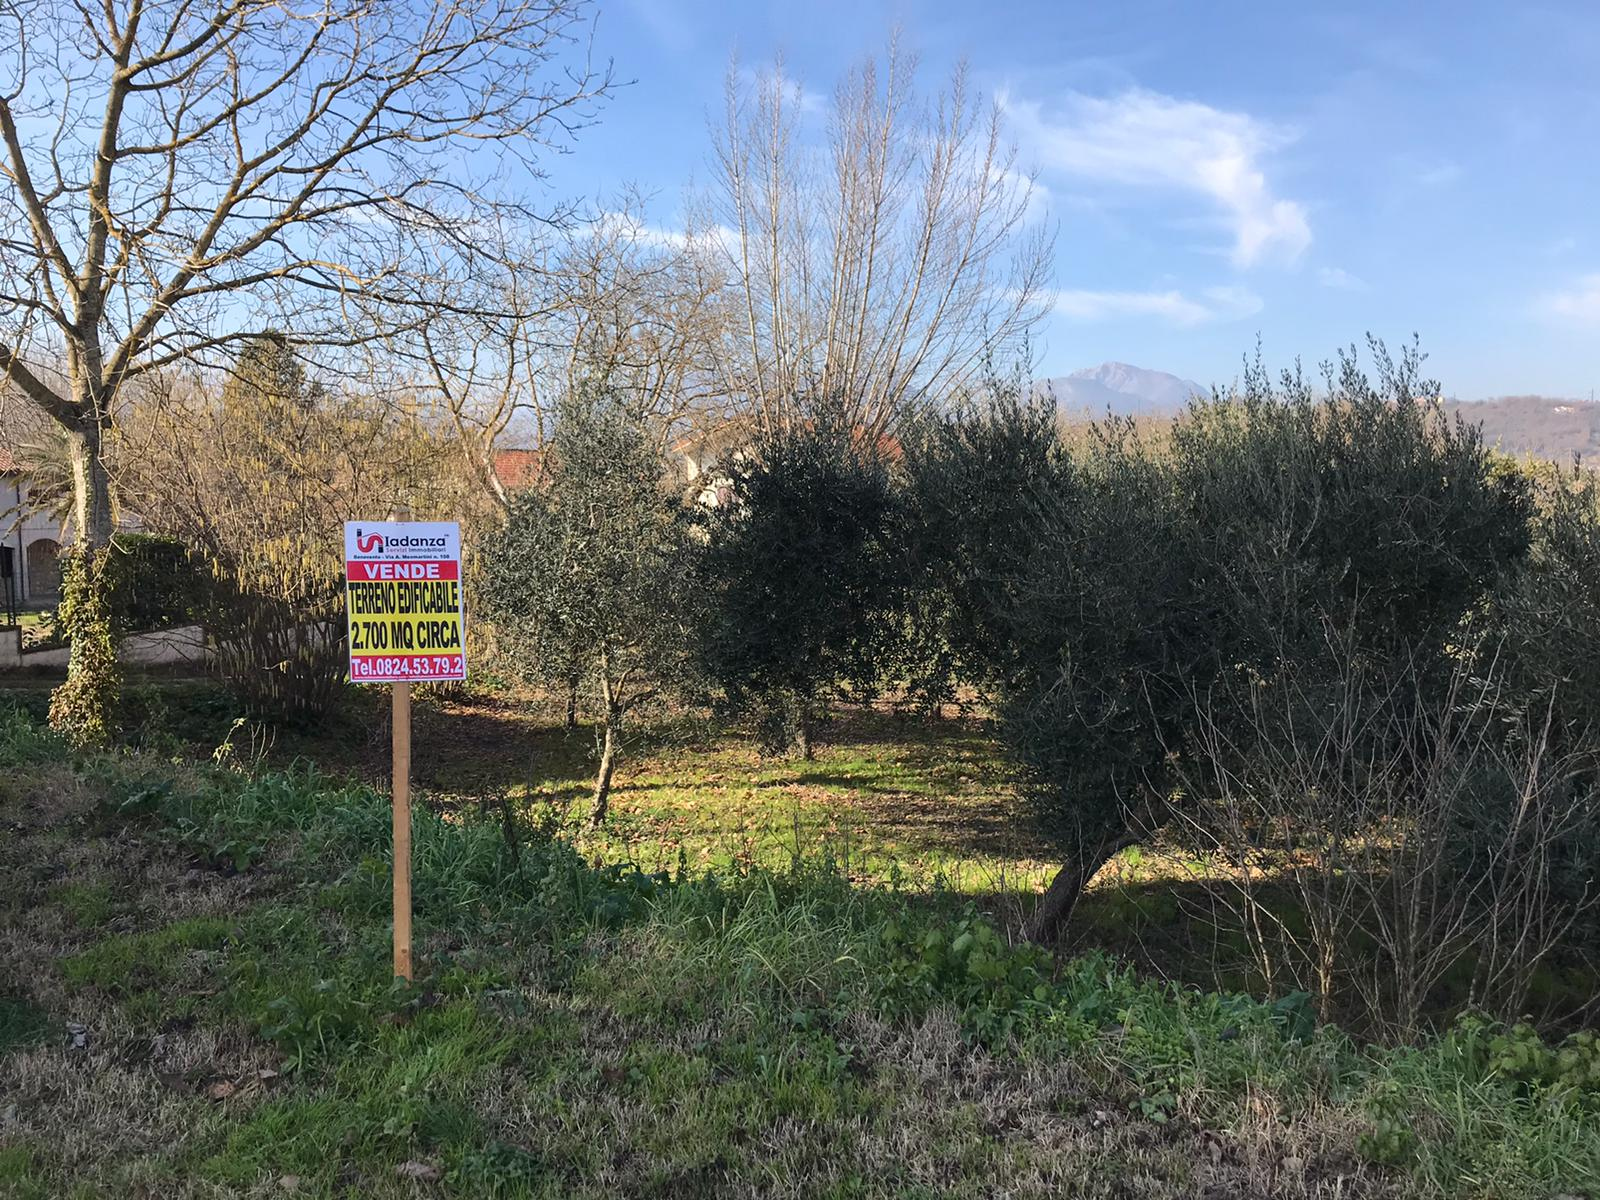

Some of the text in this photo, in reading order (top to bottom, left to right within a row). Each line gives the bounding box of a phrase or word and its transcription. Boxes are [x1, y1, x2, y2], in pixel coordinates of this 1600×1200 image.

[363, 563, 440, 580] VENDE
[348, 581, 459, 614] TERRENO EDIFICABILE
[351, 620, 460, 650] 2.700 MQ CIRCA
[351, 656, 462, 676] Tel.0824.53.79.2
